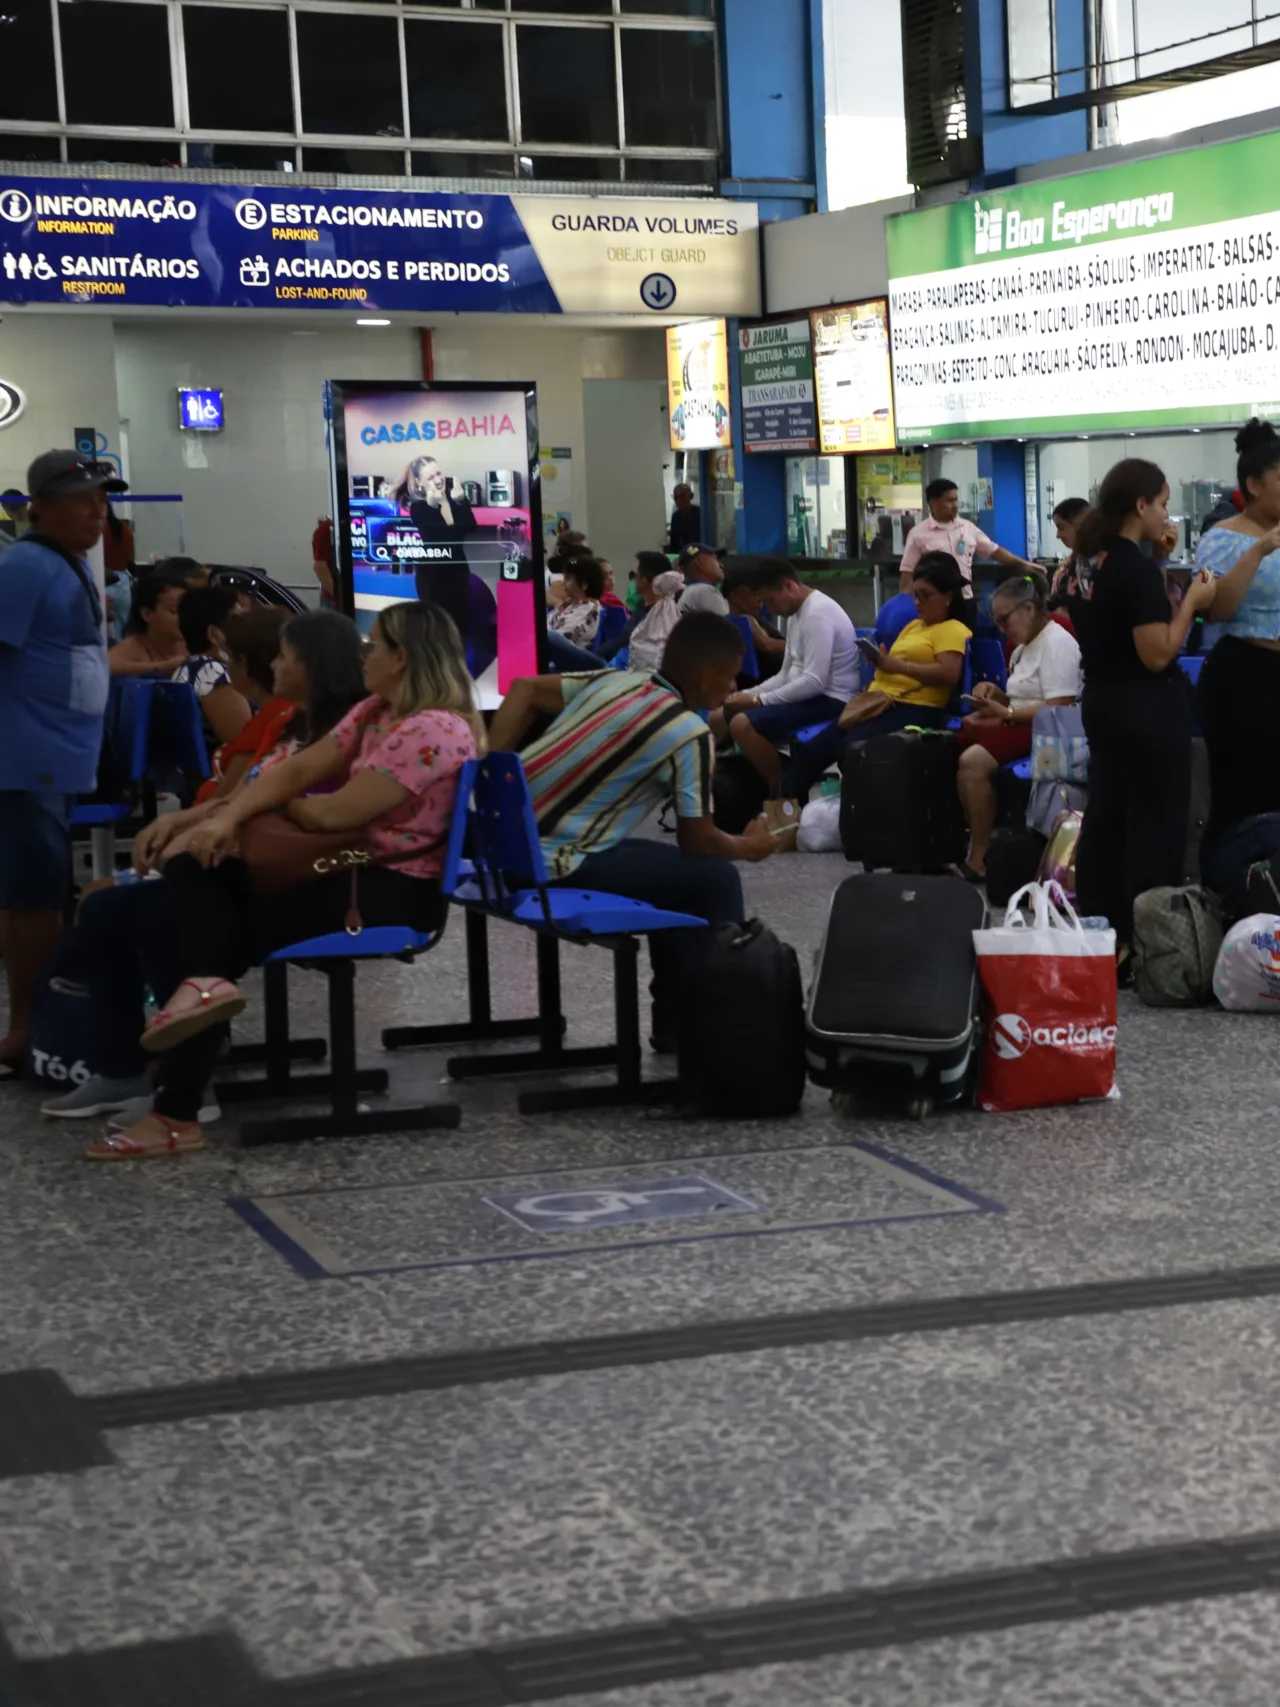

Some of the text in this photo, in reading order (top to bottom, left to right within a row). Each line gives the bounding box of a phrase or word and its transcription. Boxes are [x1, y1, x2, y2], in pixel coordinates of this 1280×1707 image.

[35, 195, 197, 223] INFORMAÇÃO
[271, 204, 484, 230] ESTACIONAMENTO
[1005, 191, 1175, 250] Boa Esperança
[37, 220, 115, 235] INFORMATION
[272, 227, 319, 241] PARKING
[551, 214, 738, 236] GUARDA VOLUMES
[61, 253, 200, 279] SANITÁRIOS
[607, 248, 706, 264] OBEJCT GUARD
[275, 257, 510, 283] ACHADOS E PERDIDOS
[927, 279, 986, 310] PARAUAPEBAS
[1111, 255, 1136, 284] LUIS
[1143, 241, 1215, 279] IMPERATRIZ
[1224, 231, 1273, 267] BALSAS
[62, 281, 126, 295] RESTROOM
[275, 286, 368, 300] LOST-AND-FOUND
[939, 319, 975, 346] SALINAS
[980, 312, 1027, 341] ALTAMIRA
[1085, 296, 1140, 329] PINHEIRO
[1147, 286, 1209, 321] CAROLINA
[1217, 272, 1258, 311] BAIÃO
[753, 327, 788, 346] JARUMA
[896, 360, 947, 387] PARAGOMINAS
[952, 356, 988, 383] ESTREITO
[993, 353, 1020, 379] CONC.
[1022, 347, 1070, 376] ARAGUAIA
[1100, 336, 1128, 369] FÉLIX
[1136, 334, 1184, 366] RONDON
[1193, 325, 1256, 361] MOCAJUBA
[1266, 323, 1277, 351] D.
[360, 414, 516, 446] CASASBAHIA
[386, 532, 424, 546] BLAC
